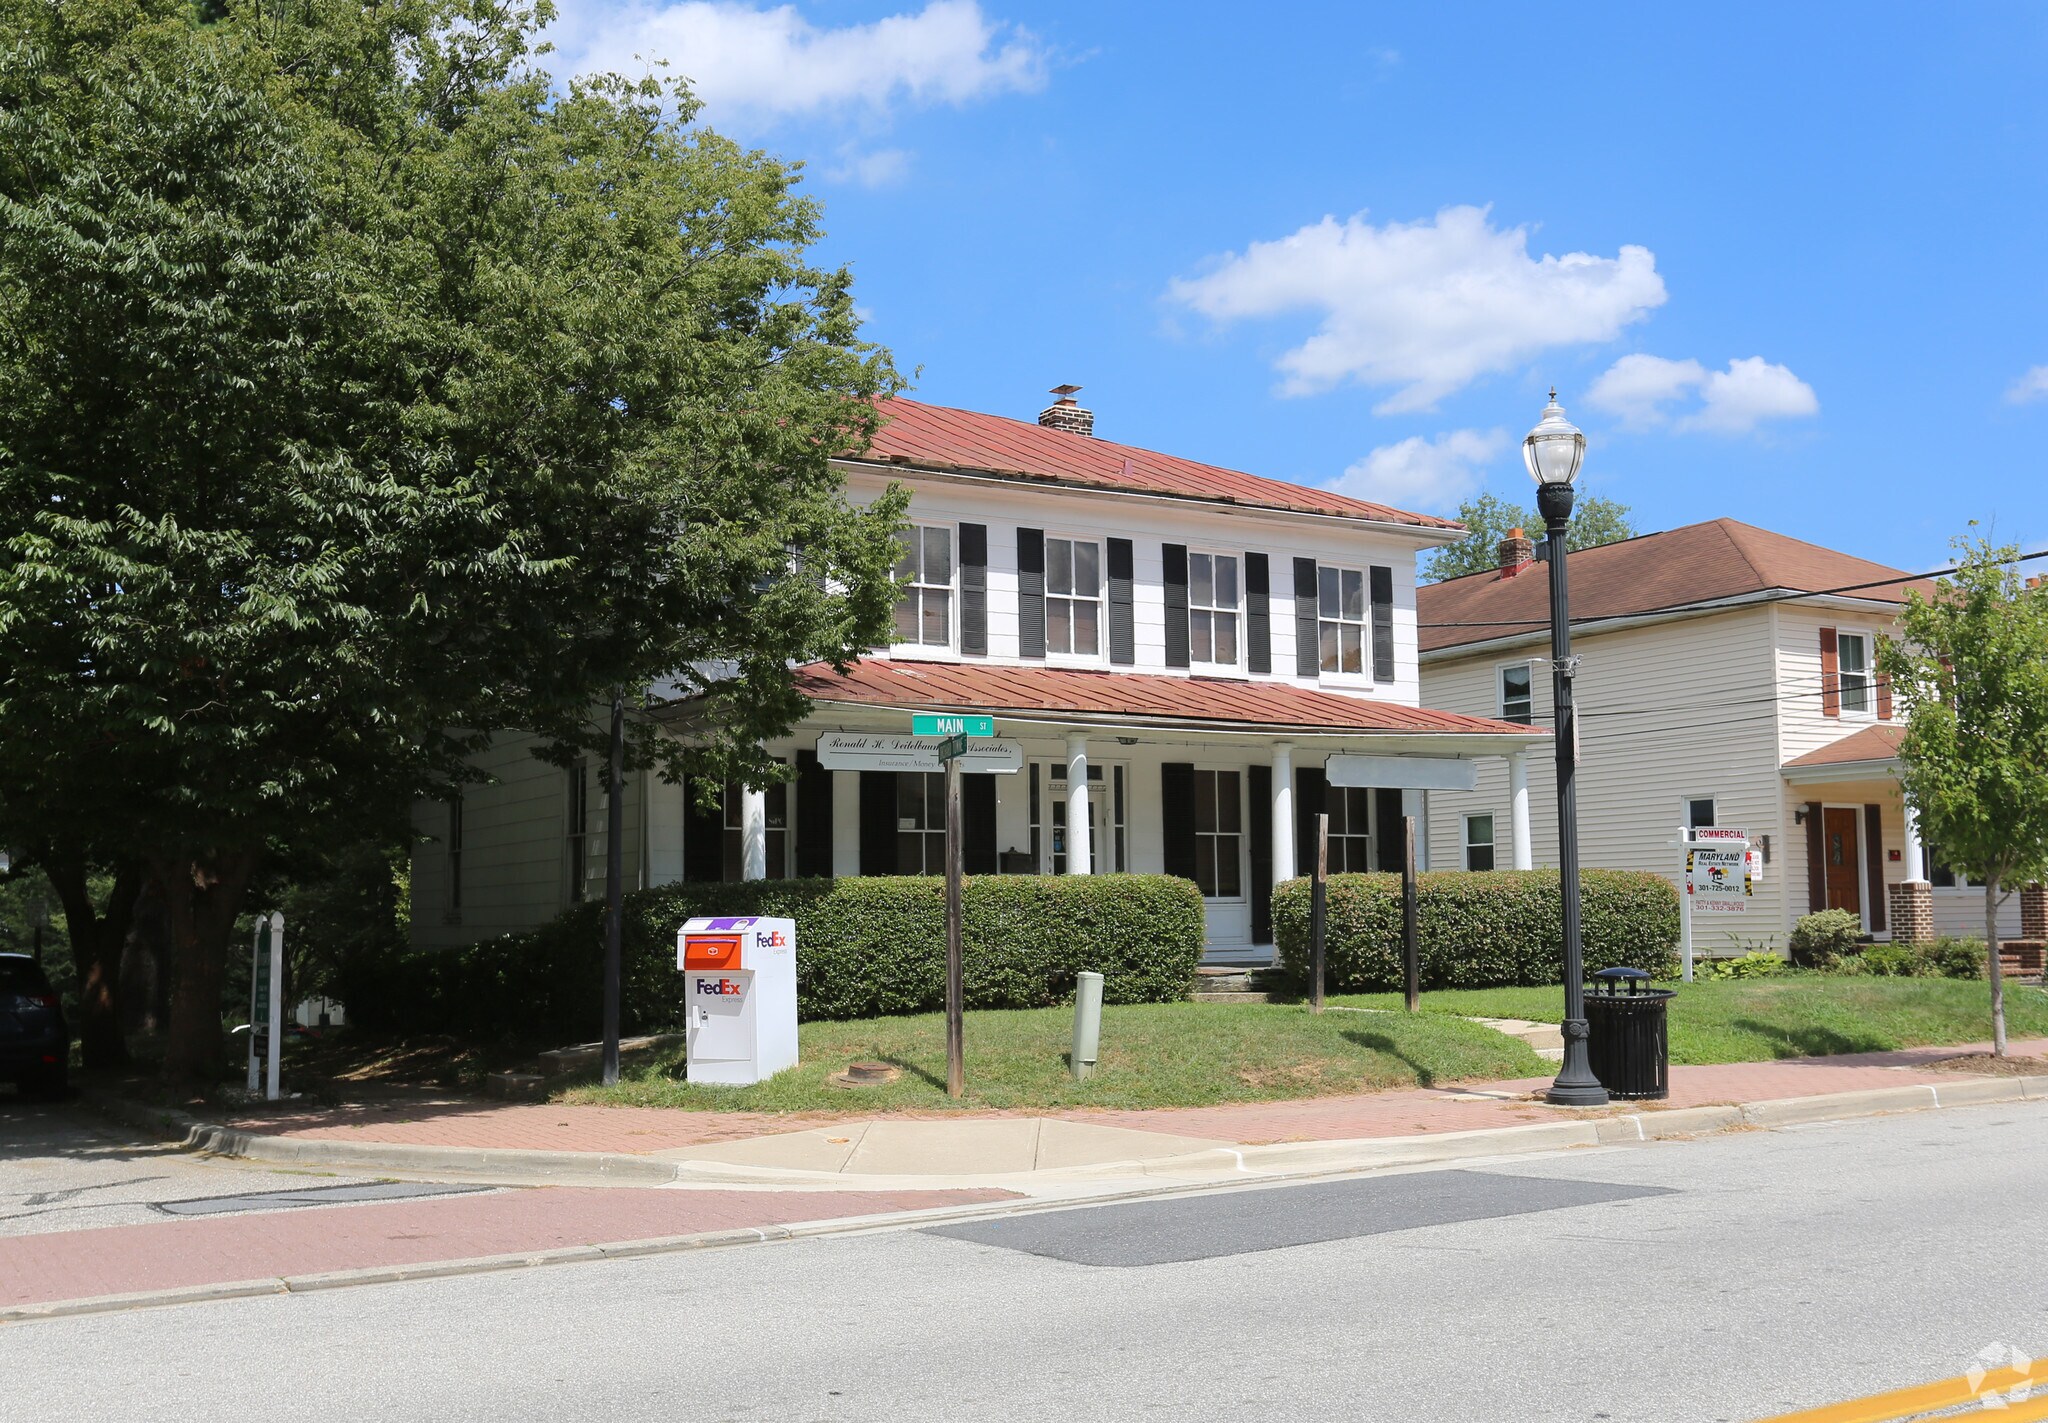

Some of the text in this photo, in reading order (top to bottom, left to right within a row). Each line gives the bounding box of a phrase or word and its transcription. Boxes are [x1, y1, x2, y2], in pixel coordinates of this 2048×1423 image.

[937, 718, 987, 733] MAIN ST
[829, 737, 868, 749] Ronald
[1698, 829, 1745, 839] COMMERCIAL
[1698, 852, 1740, 861] MARYLAND
[1698, 884, 1740, 893] 301-725-0012
[756, 931, 786, 948] FedEx
[696, 978, 741, 995] FedEx
